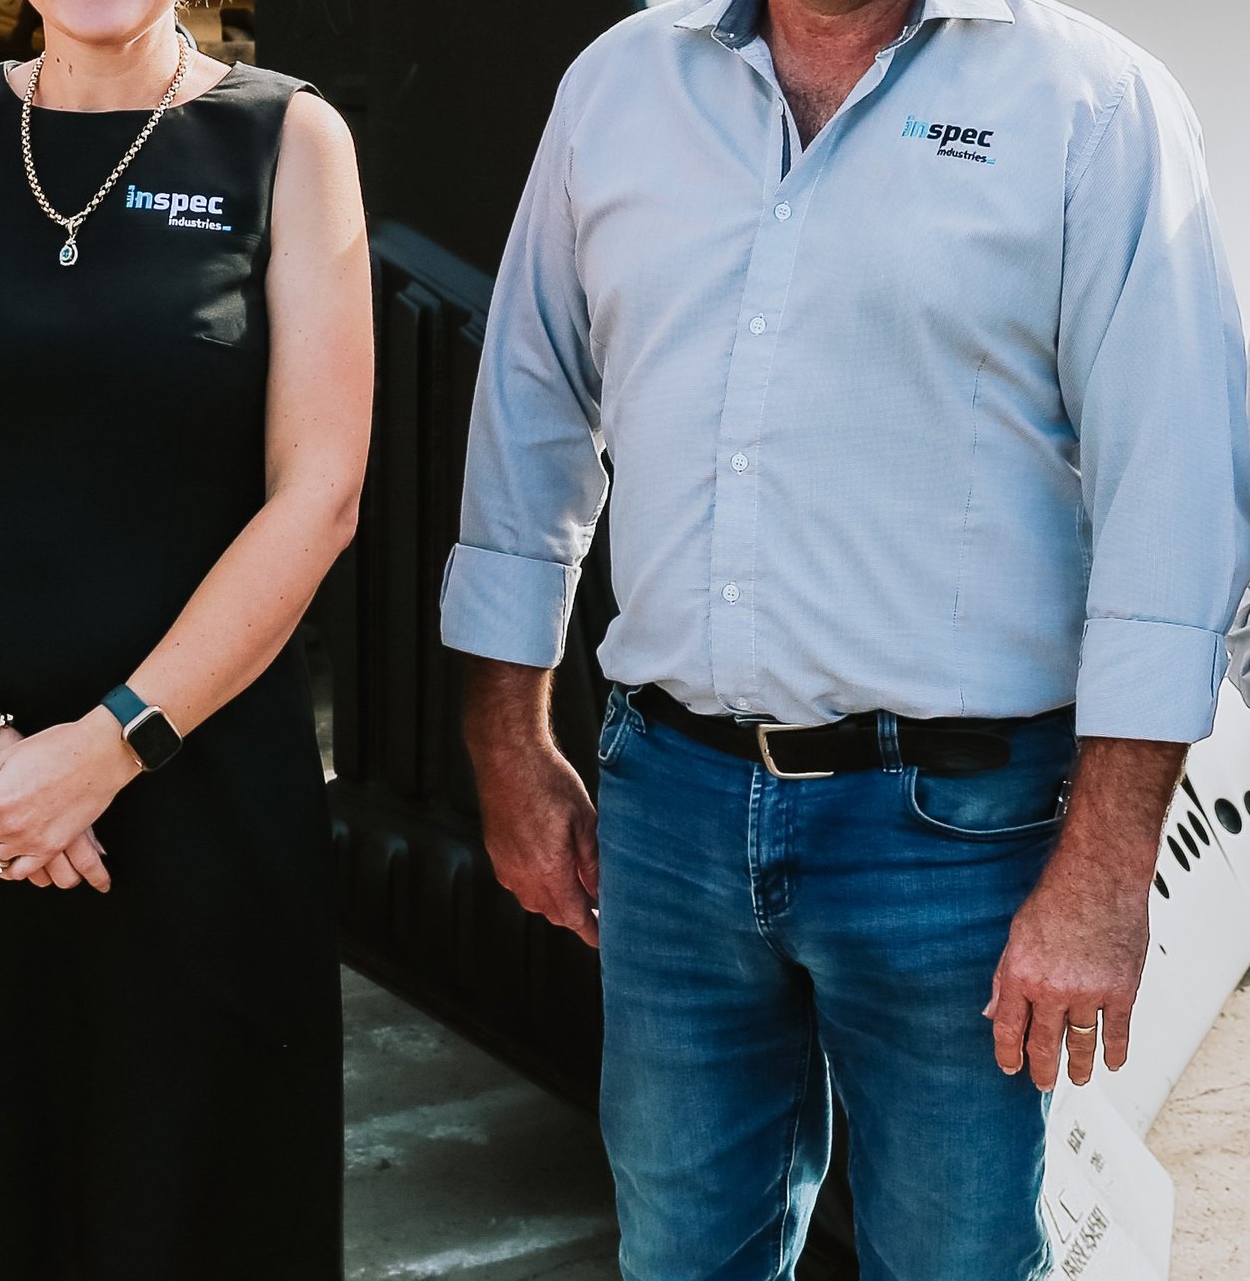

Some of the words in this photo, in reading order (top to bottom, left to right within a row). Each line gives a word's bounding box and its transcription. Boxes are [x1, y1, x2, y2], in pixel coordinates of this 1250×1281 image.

[902, 115, 994, 149] inspec
[936, 148, 988, 163] industries
[126, 185, 224, 217] inspec
[168, 217, 222, 231] industries
